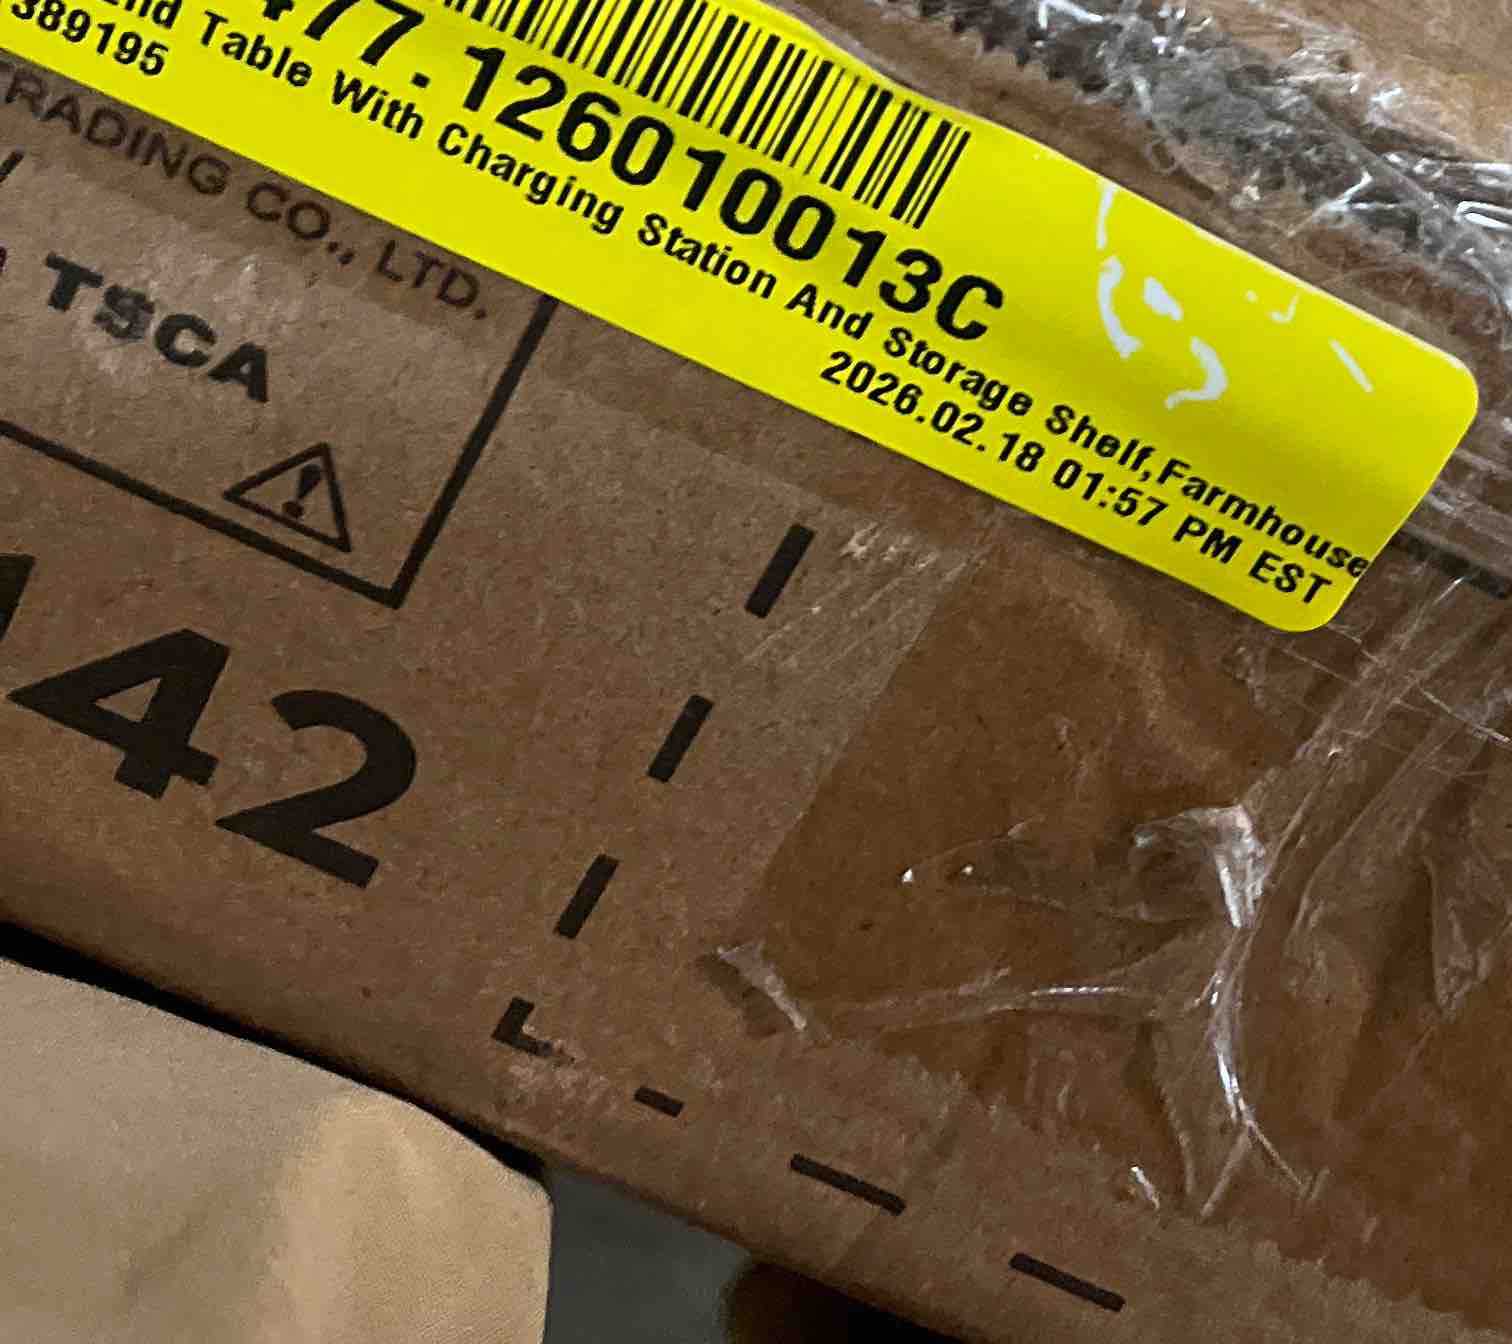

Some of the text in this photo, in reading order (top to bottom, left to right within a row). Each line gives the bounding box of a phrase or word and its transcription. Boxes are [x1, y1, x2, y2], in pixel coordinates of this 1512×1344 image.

[0, 62, 233, 196] RADING
[373, 239, 488, 321] LTD.
[199, 9, 313, 87] Table
[331, 69, 422, 140] With
[438, 122, 625, 235] Charging
[637, 213, 777, 300] Station
[785, 283, 873, 341] And
[883, 326, 1033, 416] Storage
[45, 252, 271, 403] TSCA
[820, 351, 1333, 605] 2026.02.18 01:57 PM EST
[0, 553, 417, 889] 42
